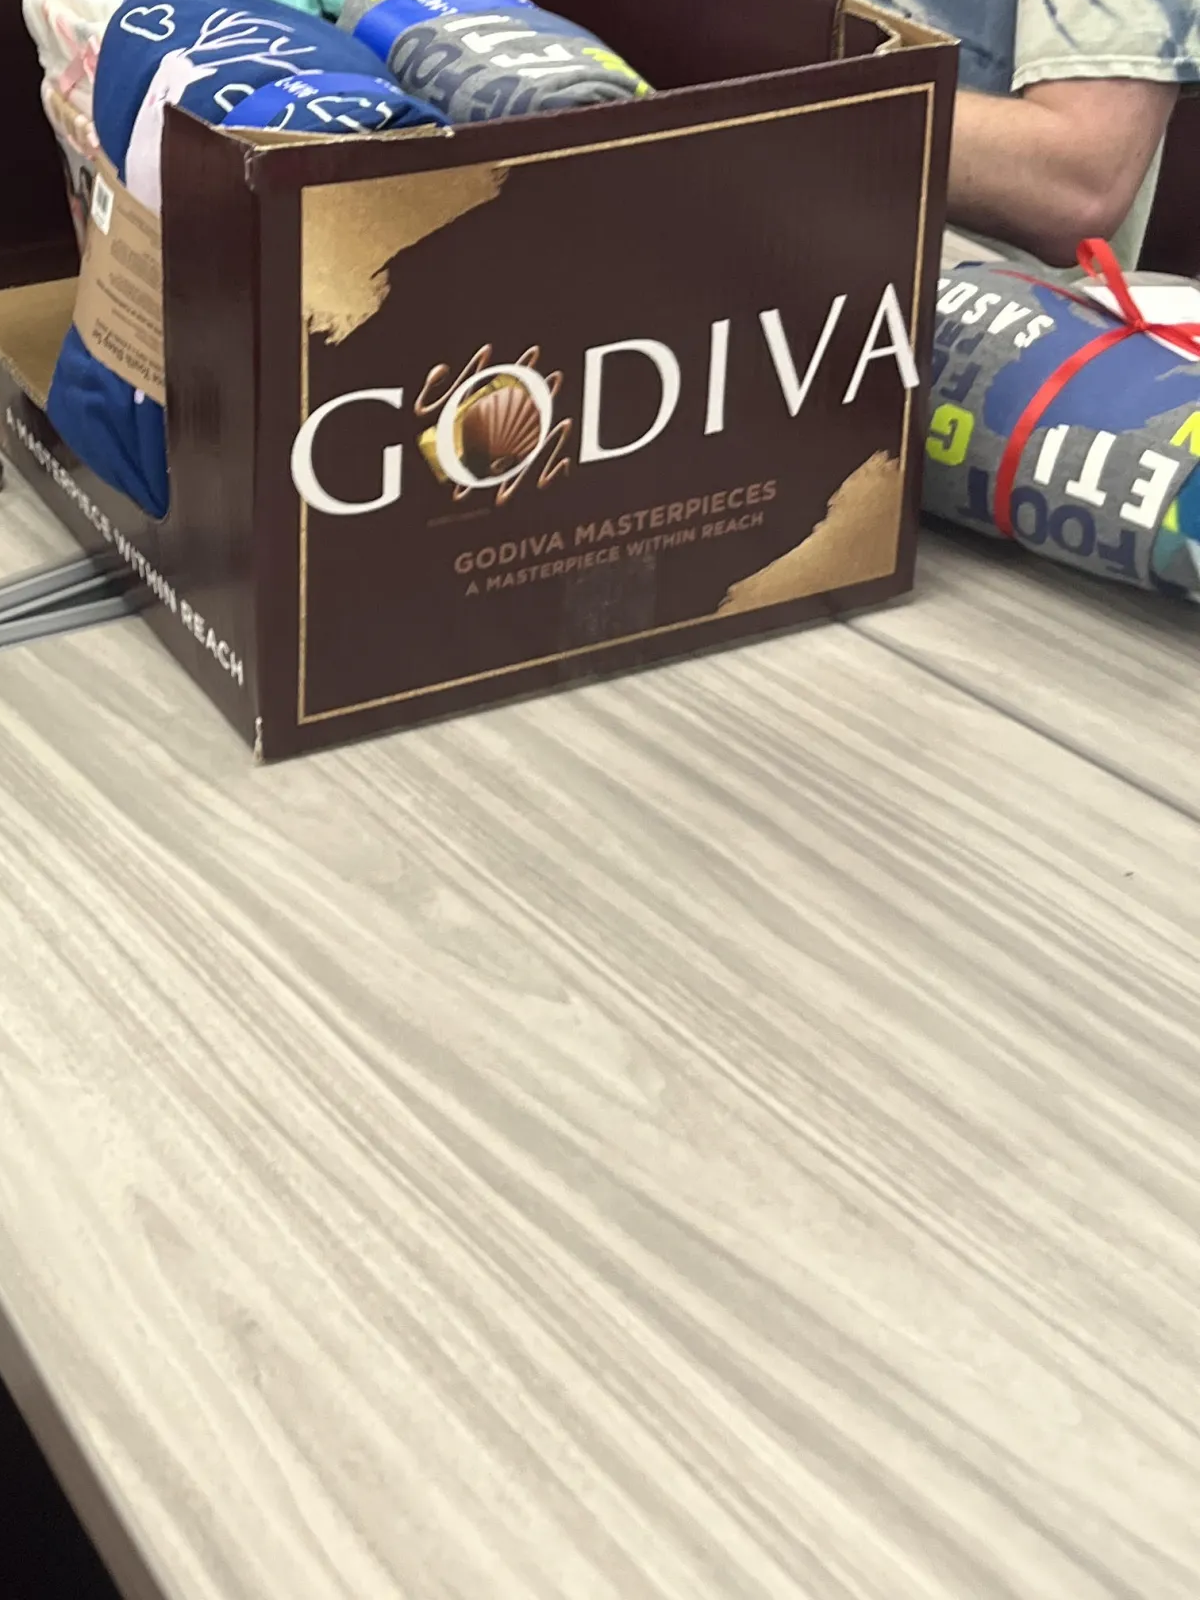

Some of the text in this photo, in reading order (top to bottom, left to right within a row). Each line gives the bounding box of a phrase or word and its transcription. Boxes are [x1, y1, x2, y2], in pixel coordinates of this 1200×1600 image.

[290, 283, 921, 516] GODIVA
[16, 417, 113, 543] MASTERPIECE
[113, 527, 178, 614] WITHIN
[180, 598, 245, 687] REACH
[453, 480, 778, 575] GODIVA MASTERPIECES
[465, 510, 765, 598] A MASTERPIECE WITHIN REACH
